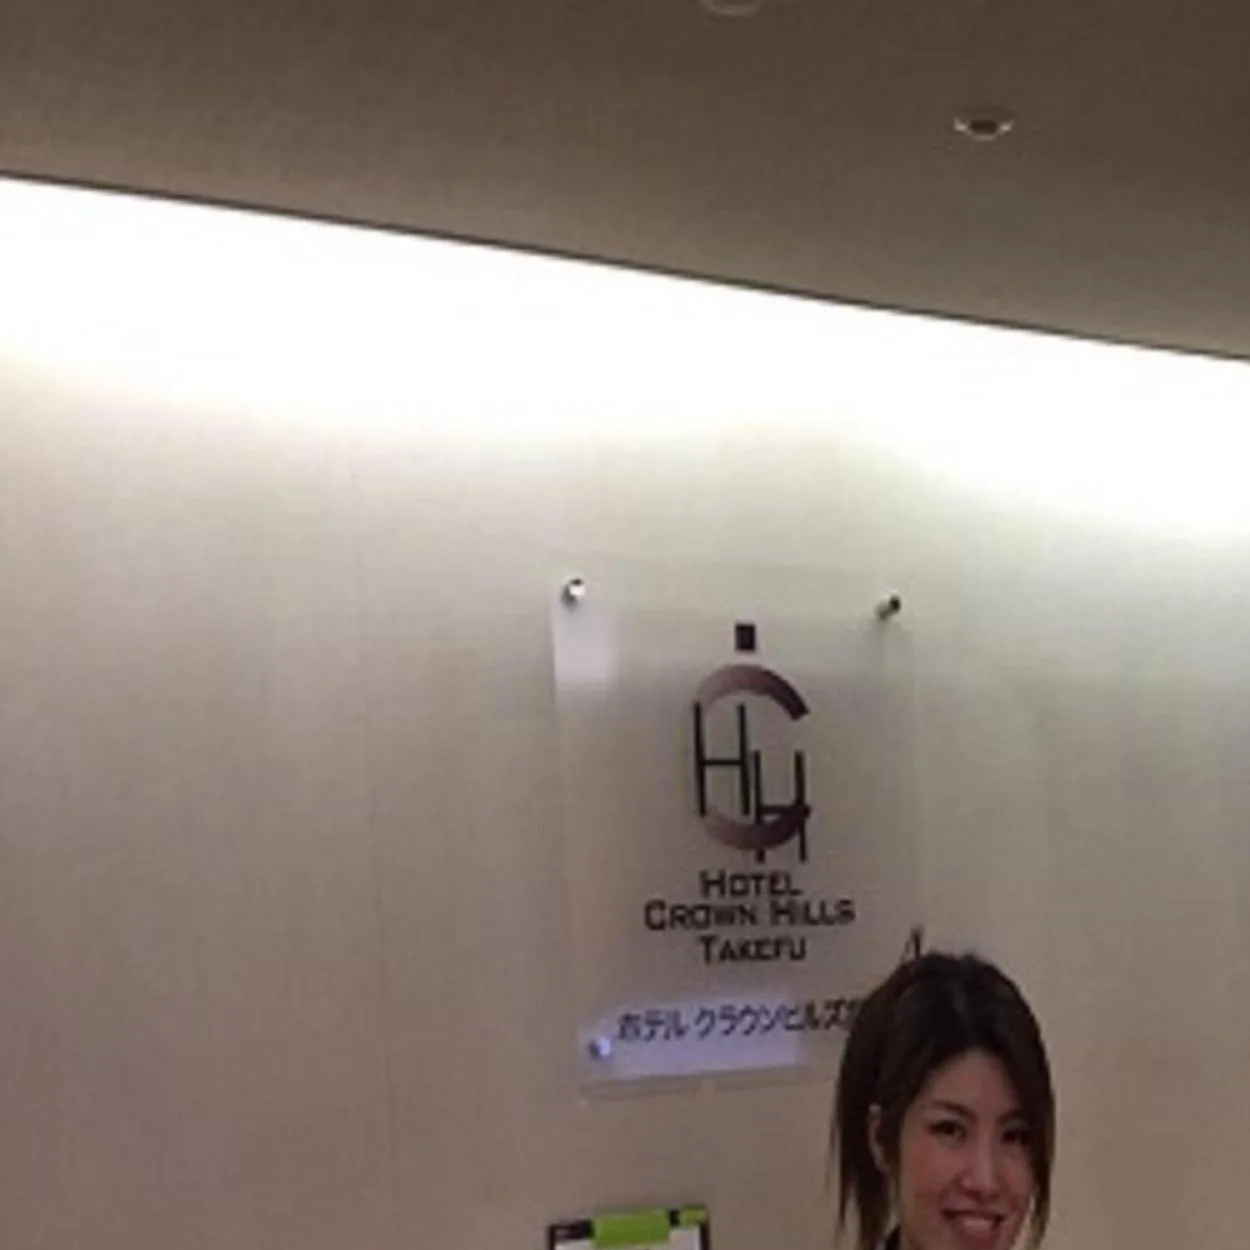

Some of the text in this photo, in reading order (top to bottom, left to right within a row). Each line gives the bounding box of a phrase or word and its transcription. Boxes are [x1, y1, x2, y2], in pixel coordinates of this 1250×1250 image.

[700, 869, 803, 898] HOTEL
[645, 899, 855, 930] CROWN HILLS
[699, 936, 807, 964] TAKEFU
[618, 997, 858, 1040] ホテルクラウンヒルズ
